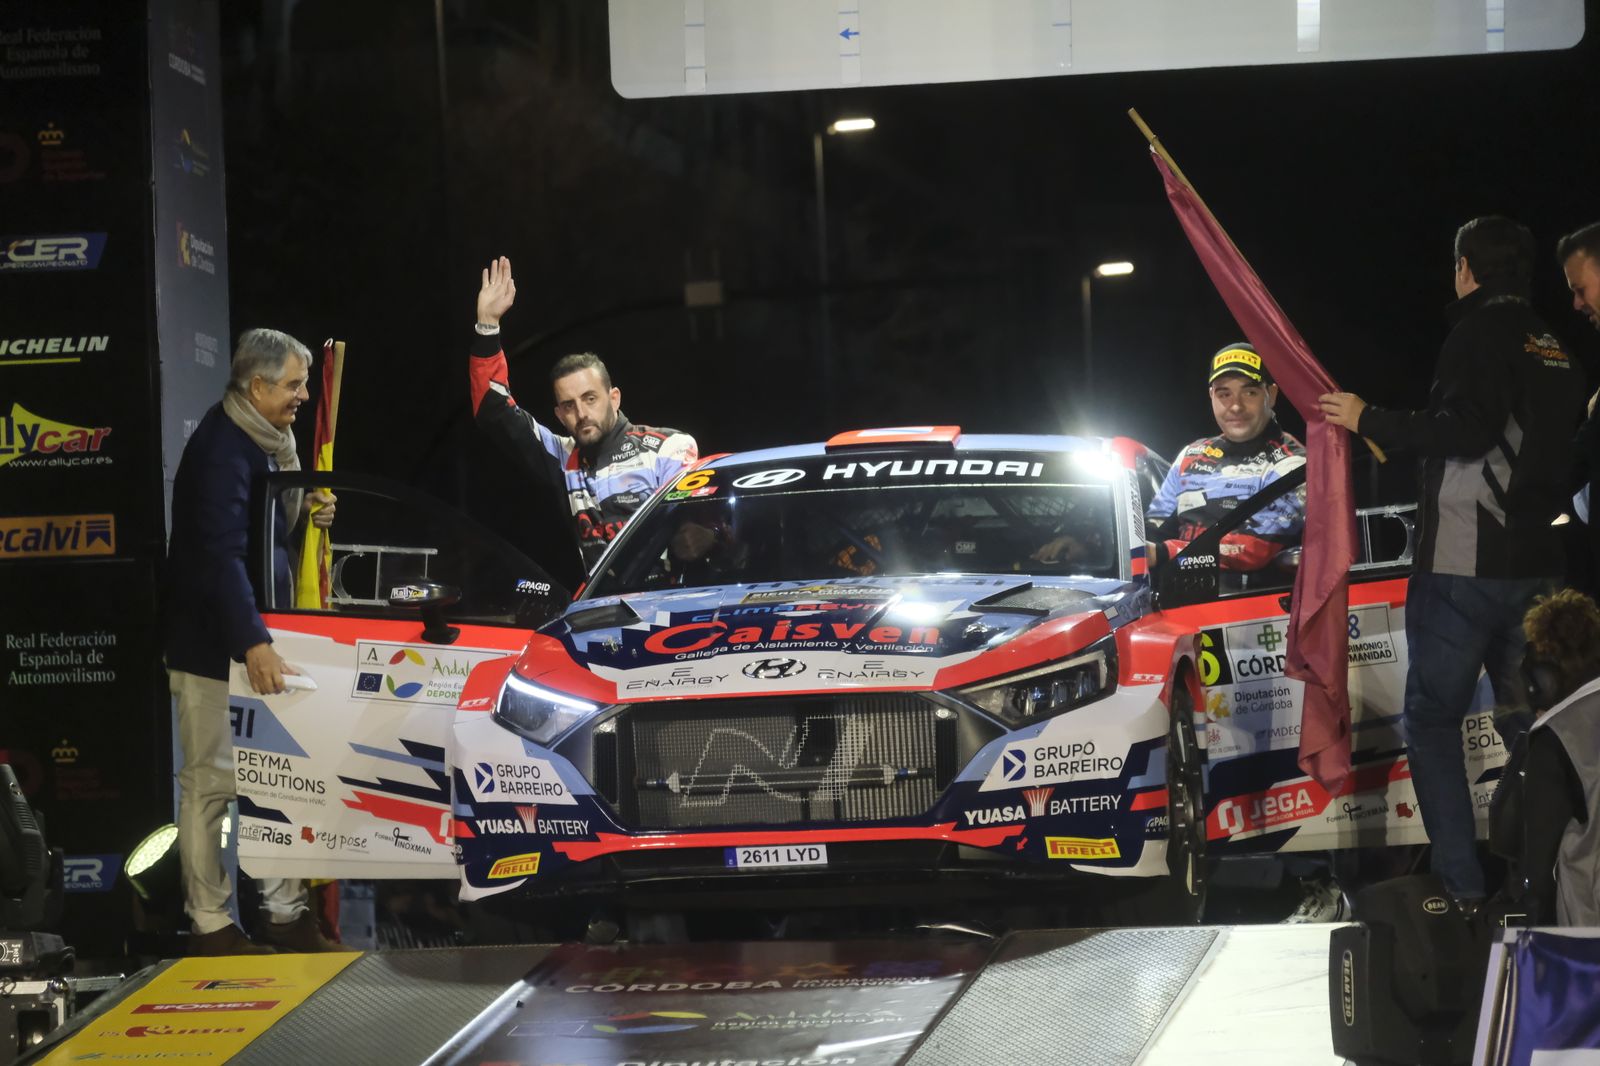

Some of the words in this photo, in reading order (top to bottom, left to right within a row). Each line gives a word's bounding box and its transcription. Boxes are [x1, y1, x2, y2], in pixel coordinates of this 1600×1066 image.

[72, 45, 90, 58] de
[0, 335, 110, 356] ICHELIN
[9, 456, 113, 468] www.rallycar.es
[823, 459, 1044, 480] HYUNDAI
[676, 469, 716, 491] 6
[0, 521, 82, 553] calvi
[1187, 555, 1215, 565] PAGID
[516, 588, 549, 596] RACING
[525, 581, 551, 592] PAGID
[6, 633, 35, 649] Real
[40, 631, 116, 648] Federación
[1348, 641, 1383, 653] RIMONIO
[675, 646, 728, 661] Gallega
[733, 643, 751, 651] de
[754, 639, 838, 650] Aislamiento
[841, 642, 851, 650] y
[855, 643, 934, 653] Ventilación
[1348, 649, 1392, 663] MANIDAD
[19, 651, 83, 670] Española
[87, 649, 104, 664] de
[431, 656, 470, 677] Andal
[1237, 655, 1287, 677] CÓRD
[8, 667, 116, 685] Automovilismo
[626, 674, 729, 691] ENAIRGY
[426, 689, 461, 700] DEPORT
[1234, 687, 1291, 703] Diputación
[1236, 705, 1248, 715] de
[1251, 700, 1293, 713] Córdoba
[1034, 741, 1096, 761] GRUPO
[237, 750, 292, 772] PEYMA
[1034, 757, 1123, 778] BARREIRO
[496, 764, 541, 779] GRUPO
[237, 768, 326, 794] SOLUTIONS
[500, 780, 563, 797] BARREIRO
[964, 805, 1026, 826] YUASA
[1050, 795, 1122, 815] BATTERY
[475, 819, 524, 835] YUASA
[538, 819, 589, 835] BATTERY
[340, 835, 367, 849] pose
[397, 840, 432, 855] INOXMAN
[1049, 840, 1116, 855] PIRELLI
[742, 848, 780, 864] 2611
[786, 847, 821, 863] LYD
[490, 855, 538, 876] PIRELLI
[564, 981, 783, 994] CÓRDOBA
